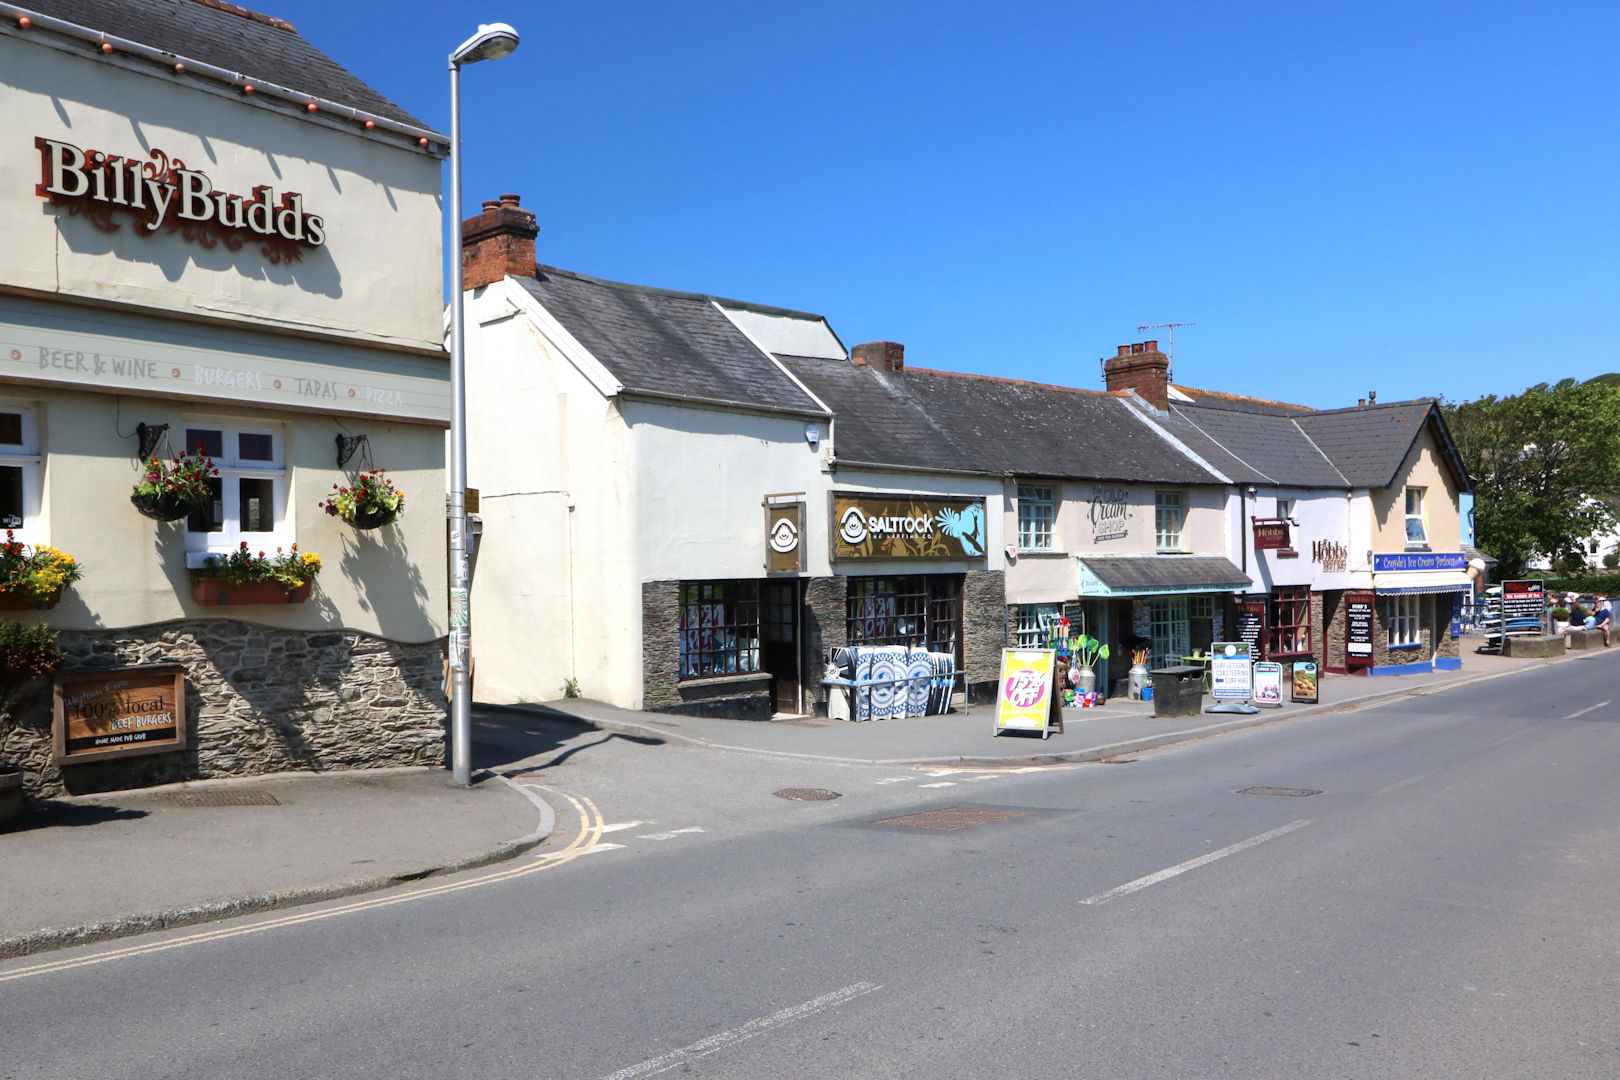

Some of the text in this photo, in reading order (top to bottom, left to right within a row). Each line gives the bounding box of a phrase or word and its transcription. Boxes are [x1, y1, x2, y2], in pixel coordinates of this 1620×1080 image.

[44, 139, 326, 247] Billy Budds
[38, 346, 158, 380] BEER & WINE
[194, 364, 263, 392] BURGERS
[294, 376, 338, 401] TAPAS
[366, 385, 403, 407] PIZZA
[1090, 495, 1128, 531] Cream
[1098, 519, 1125, 534] SHOP
[1257, 528, 1285, 538] Hobbs
[1312, 540, 1348, 562] Hobbs
[1407, 556, 1417, 568] Ice
[1417, 557, 1435, 569] Cream
[1215, 669, 1248, 677] COASTEERING
[1225, 677, 1248, 685] SURF HIRE
[1009, 686, 1041, 706] OFF
[73, 695, 165, 720] 100% local
[111, 711, 172, 731] BEEF BURGERS
[95, 736, 110, 746] HOME
[110, 735, 123, 744] MADE
[124, 734, 133, 742] PUB
